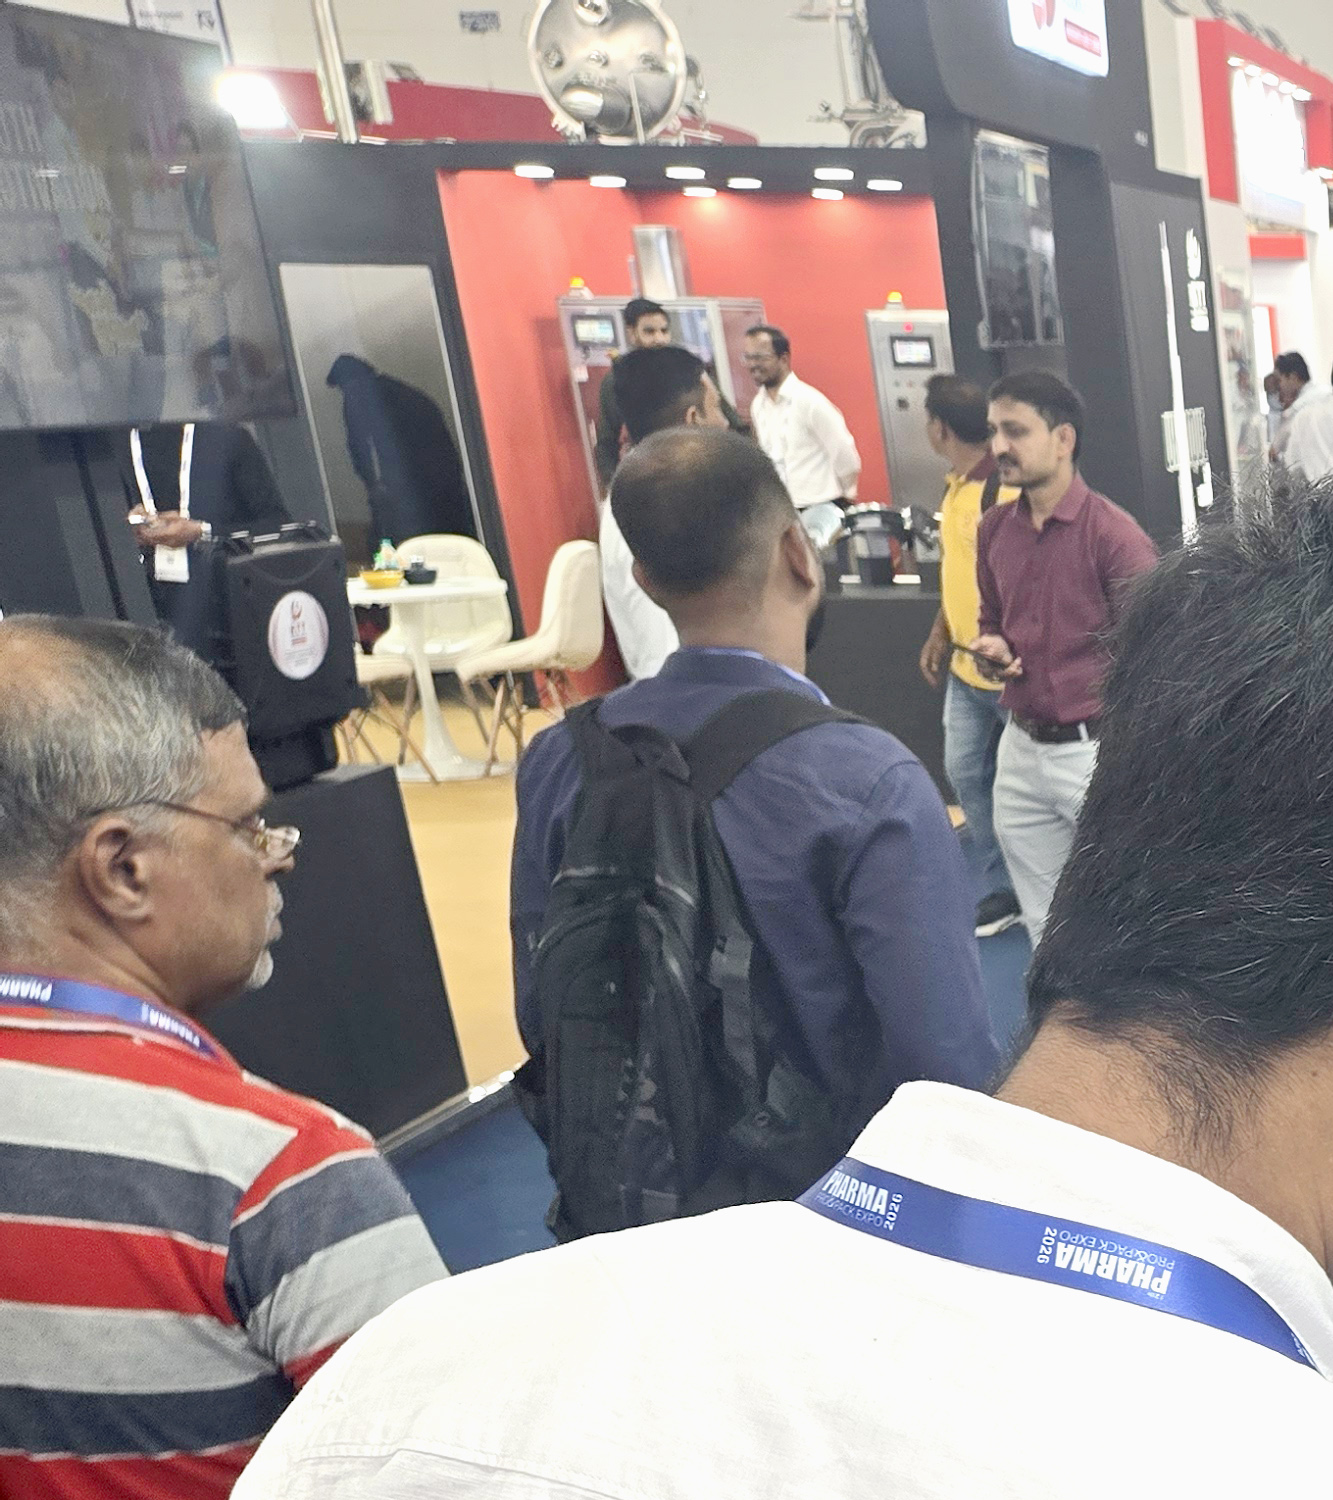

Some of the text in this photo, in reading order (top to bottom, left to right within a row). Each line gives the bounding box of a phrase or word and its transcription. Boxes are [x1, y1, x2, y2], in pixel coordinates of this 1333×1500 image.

[821, 1169, 904, 1232] PHARMA 2026
[855, 1209, 884, 1228] EXPO
[1036, 1226, 1173, 1295] PHARMA 2026
[1059, 1229, 1176, 1270] PRO&PACK EXPO
